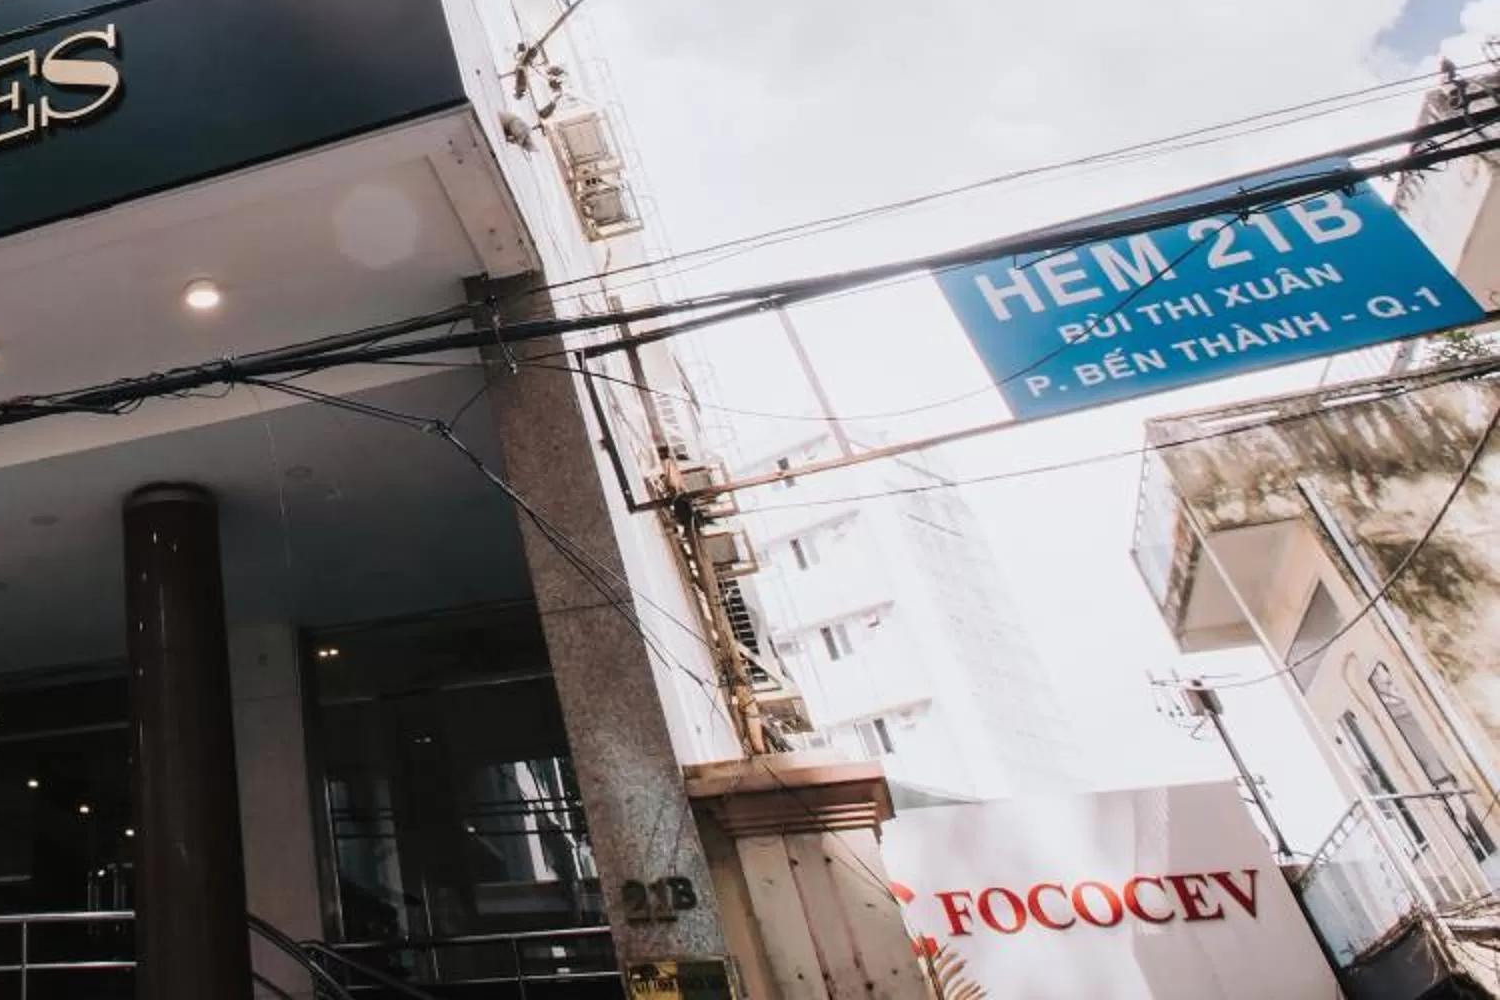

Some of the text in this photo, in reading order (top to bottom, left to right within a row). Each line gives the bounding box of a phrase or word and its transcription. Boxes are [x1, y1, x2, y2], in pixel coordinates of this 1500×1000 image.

[1187, 190, 1365, 269] 21B
[1025, 374, 1068, 398] P.
[1073, 346, 1169, 387] BẾN
[1173, 310, 1331, 360] THÀNH
[1366, 286, 1442, 320] Q.1
[1057, 263, 1344, 345] BÙI THỊ XUÂN
[934, 869, 1258, 937] FOCOCEV
